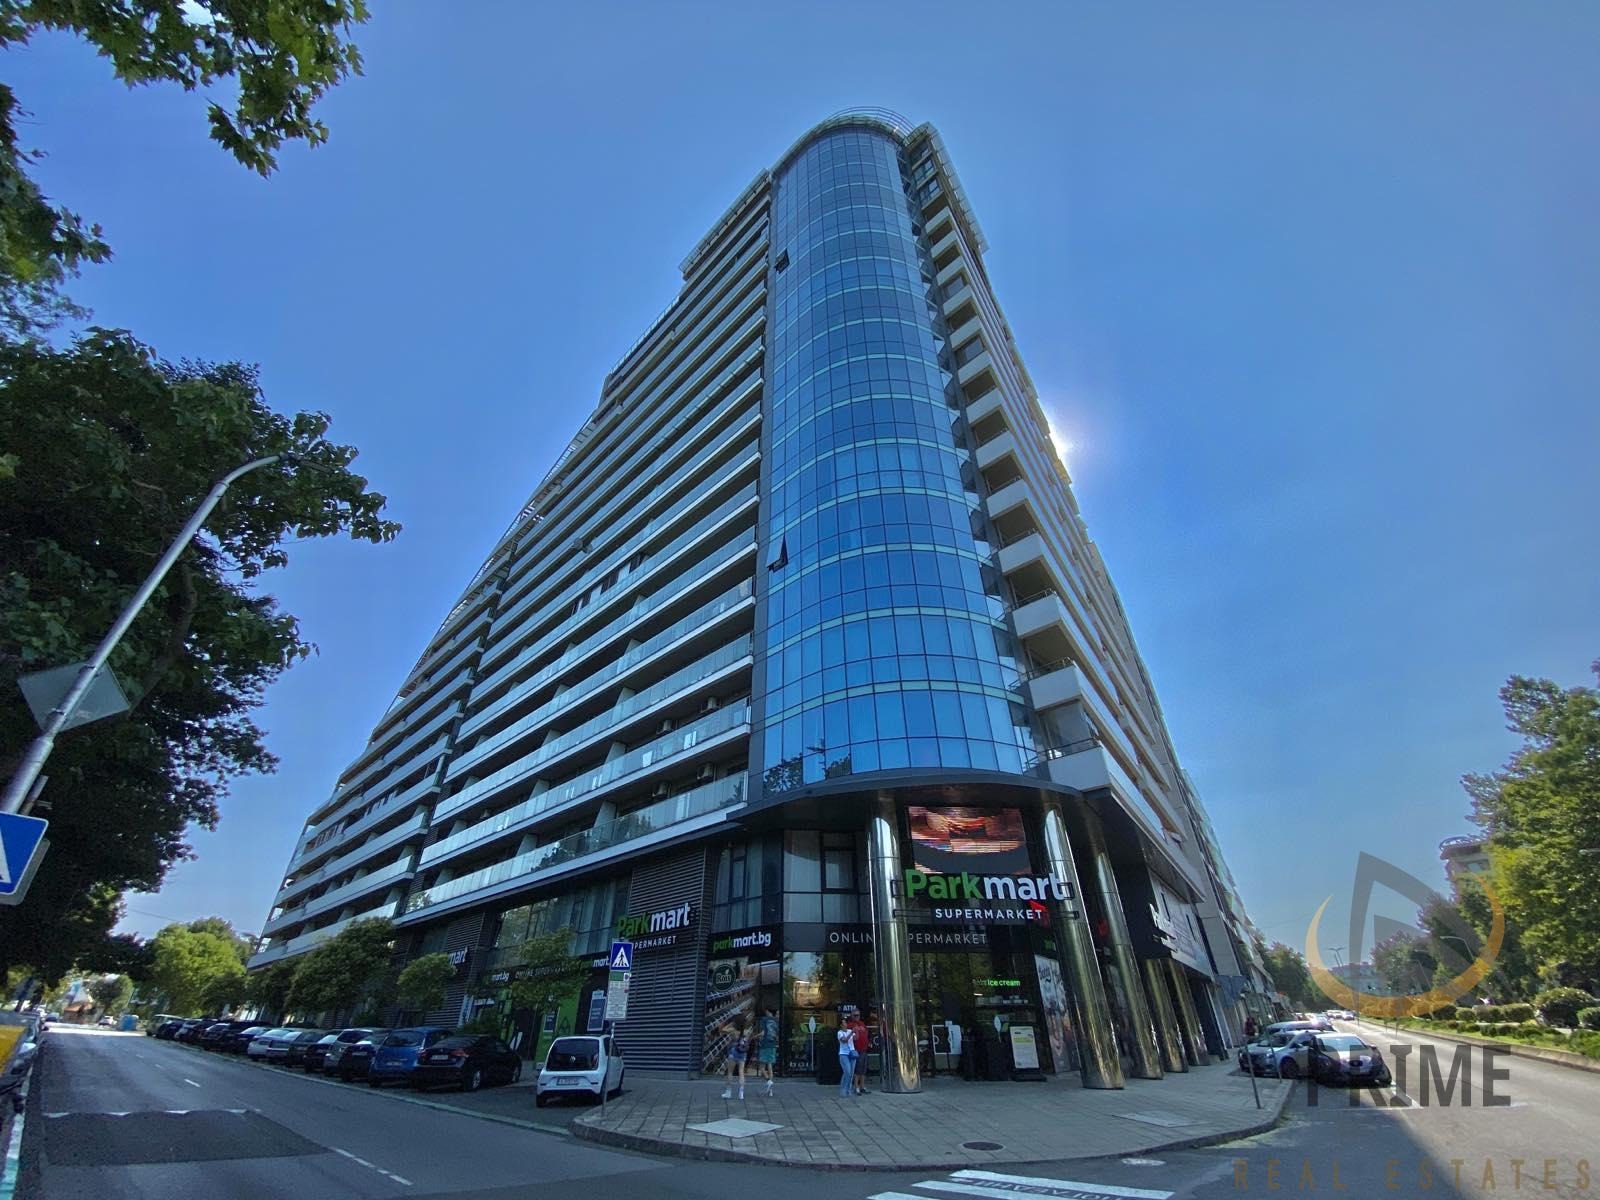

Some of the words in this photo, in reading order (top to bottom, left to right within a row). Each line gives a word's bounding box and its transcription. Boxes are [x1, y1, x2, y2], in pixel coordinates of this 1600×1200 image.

[904, 869, 1064, 900] Parkmart
[935, 908, 1042, 920] SUPERMARKET
[634, 935, 677, 950] PERMARKET
[713, 931, 772, 953] parkmart.bg
[829, 932, 874, 944] ONLIN
[908, 932, 988, 945] PERMARKET
